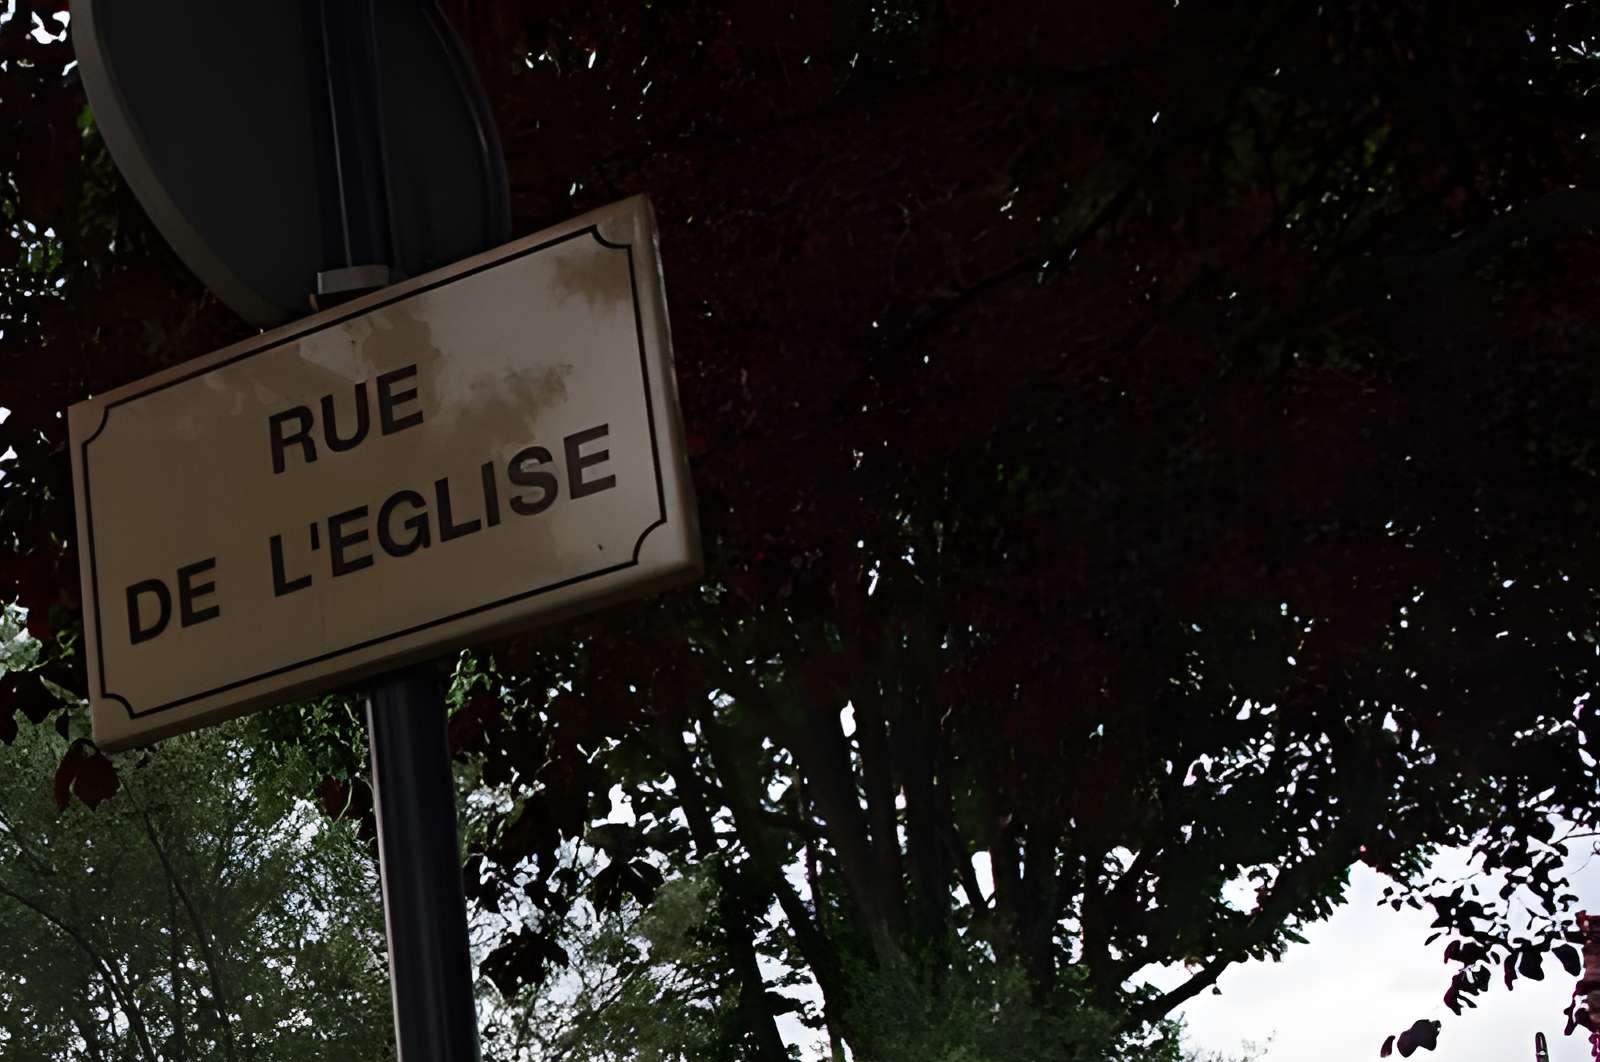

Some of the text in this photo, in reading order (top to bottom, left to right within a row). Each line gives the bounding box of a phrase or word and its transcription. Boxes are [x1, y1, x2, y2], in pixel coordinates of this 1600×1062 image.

[268, 364, 423, 474] RUE
[125, 424, 616, 645] DE L'EGLISE
